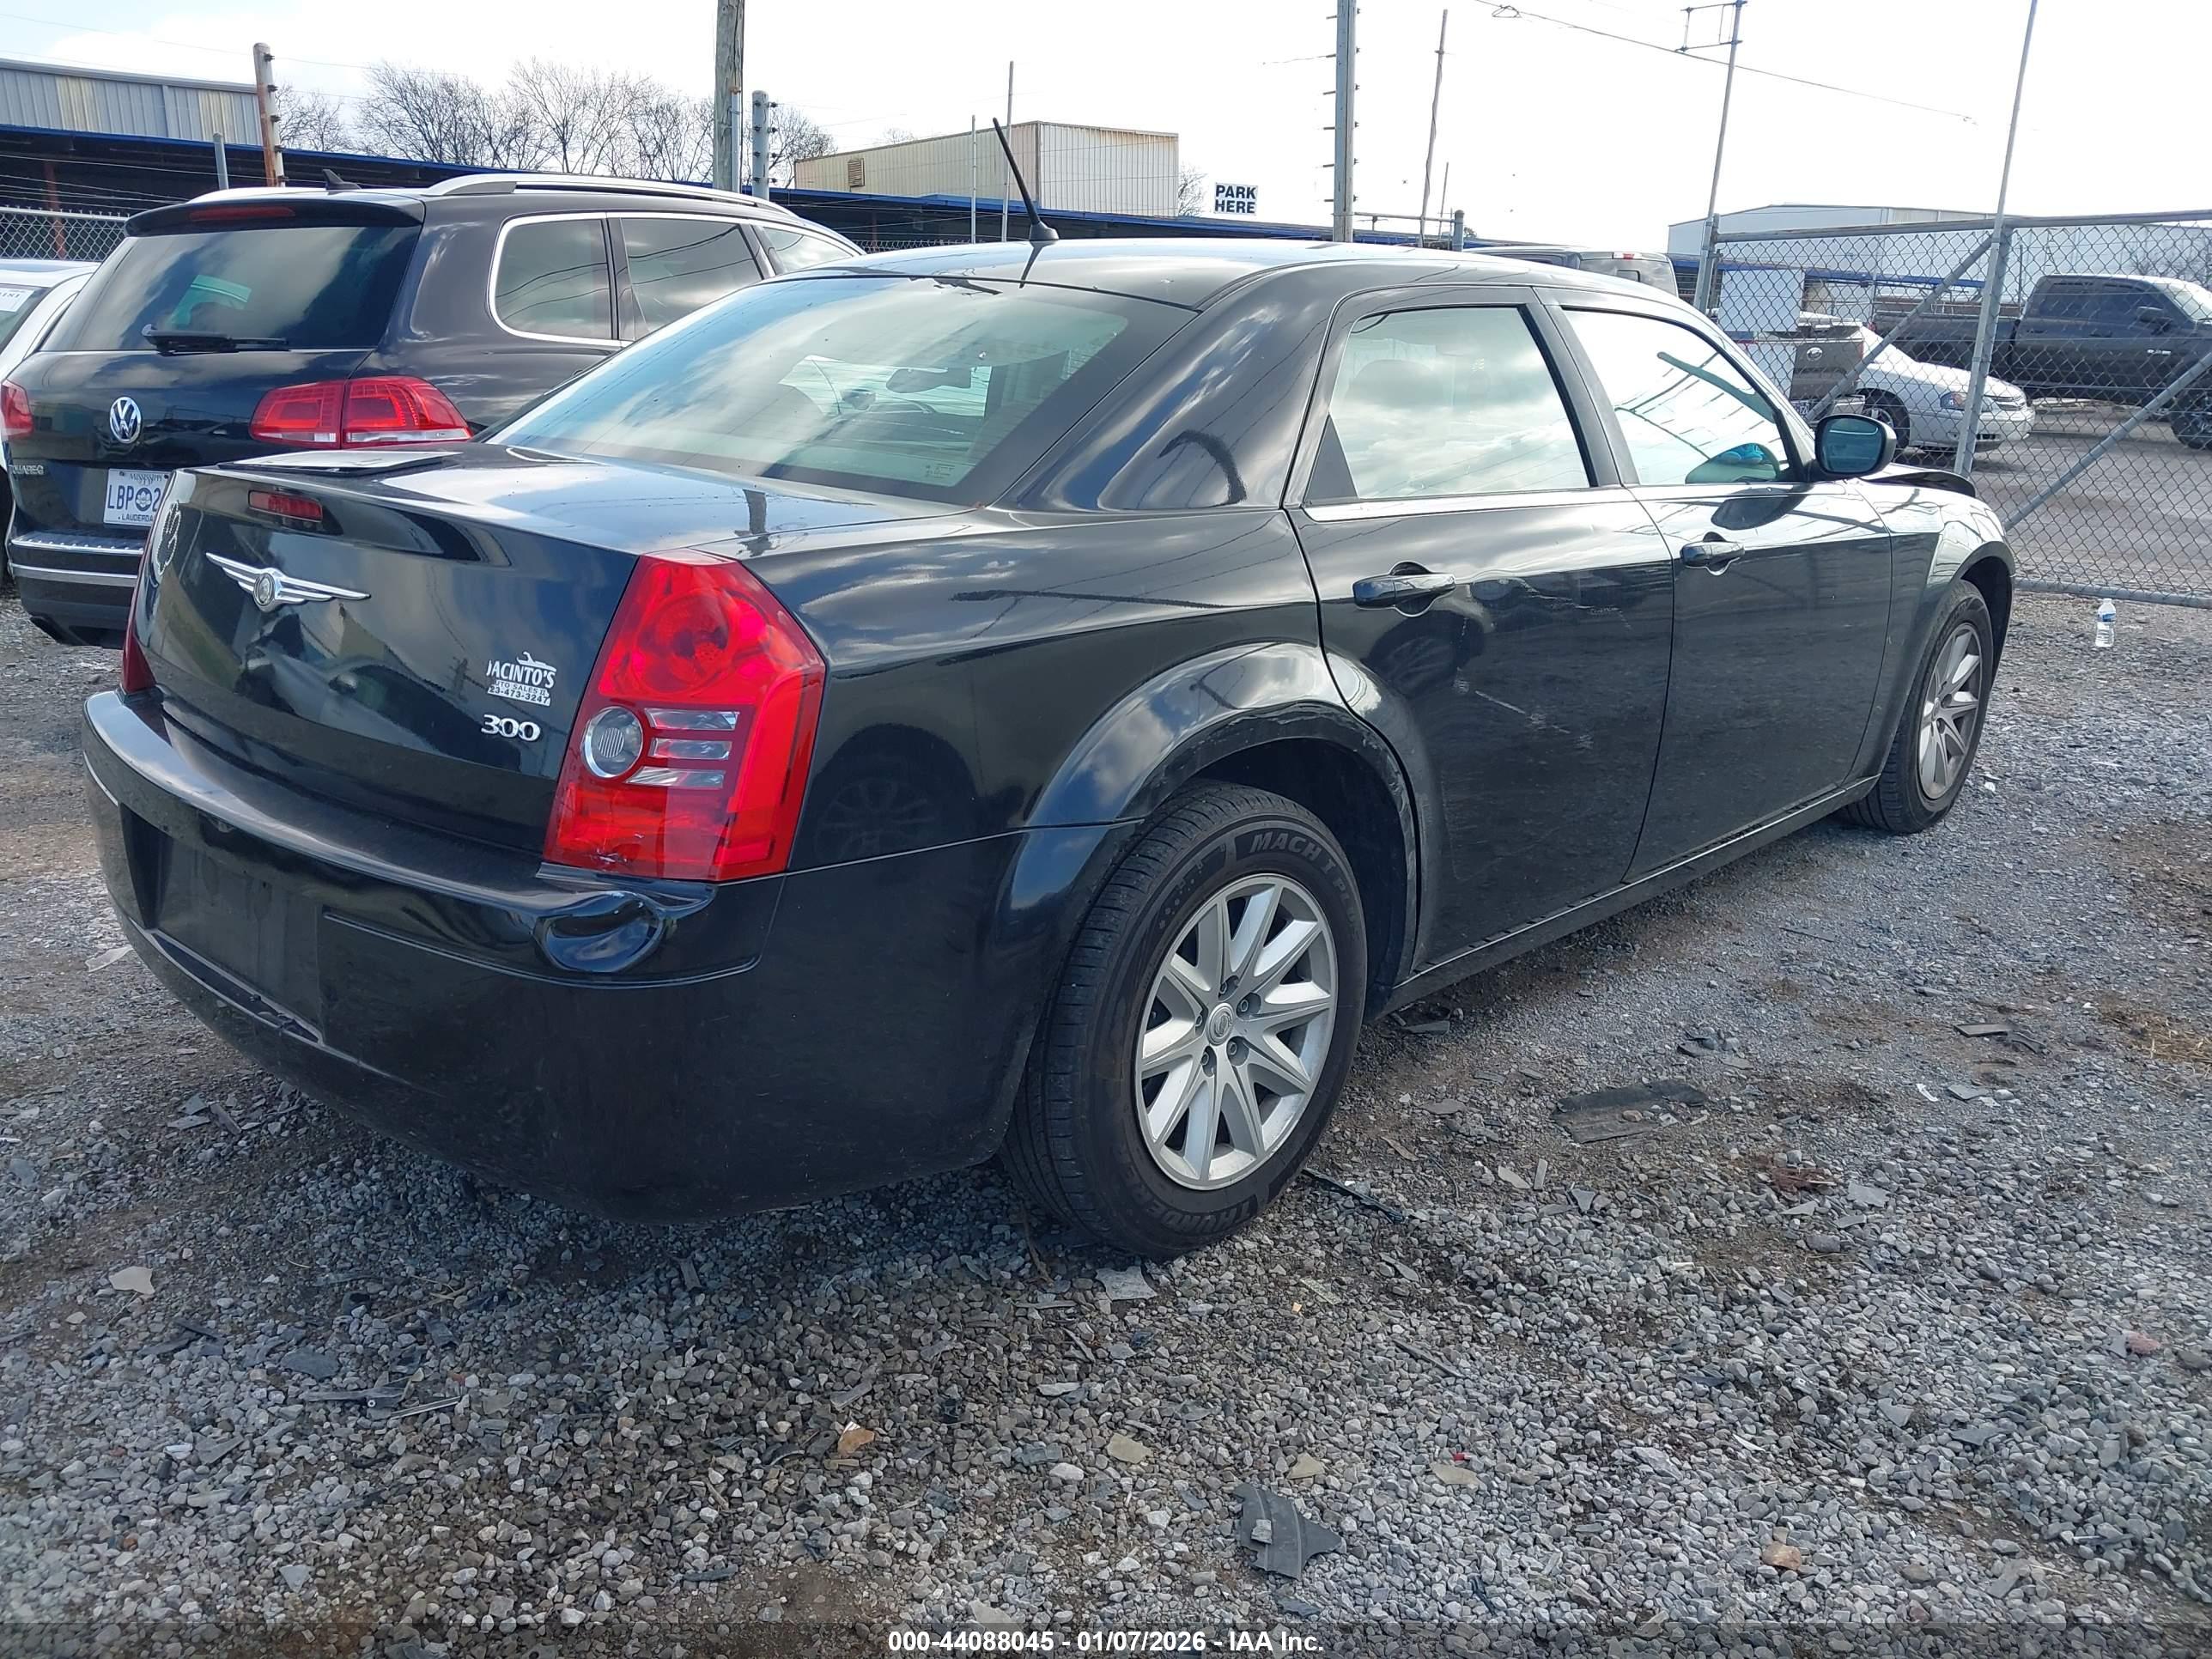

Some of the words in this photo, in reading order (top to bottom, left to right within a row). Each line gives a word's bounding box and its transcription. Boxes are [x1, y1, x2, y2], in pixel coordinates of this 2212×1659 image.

[1215, 184, 1257, 200] PARK
[1214, 198, 1256, 214] HERE
[106, 484, 134, 511] LBP
[486, 659, 556, 689] JACINTO'S
[513, 684, 539, 695] SALES
[481, 714, 541, 742] 300
[1249, 831, 1323, 861] MACH
